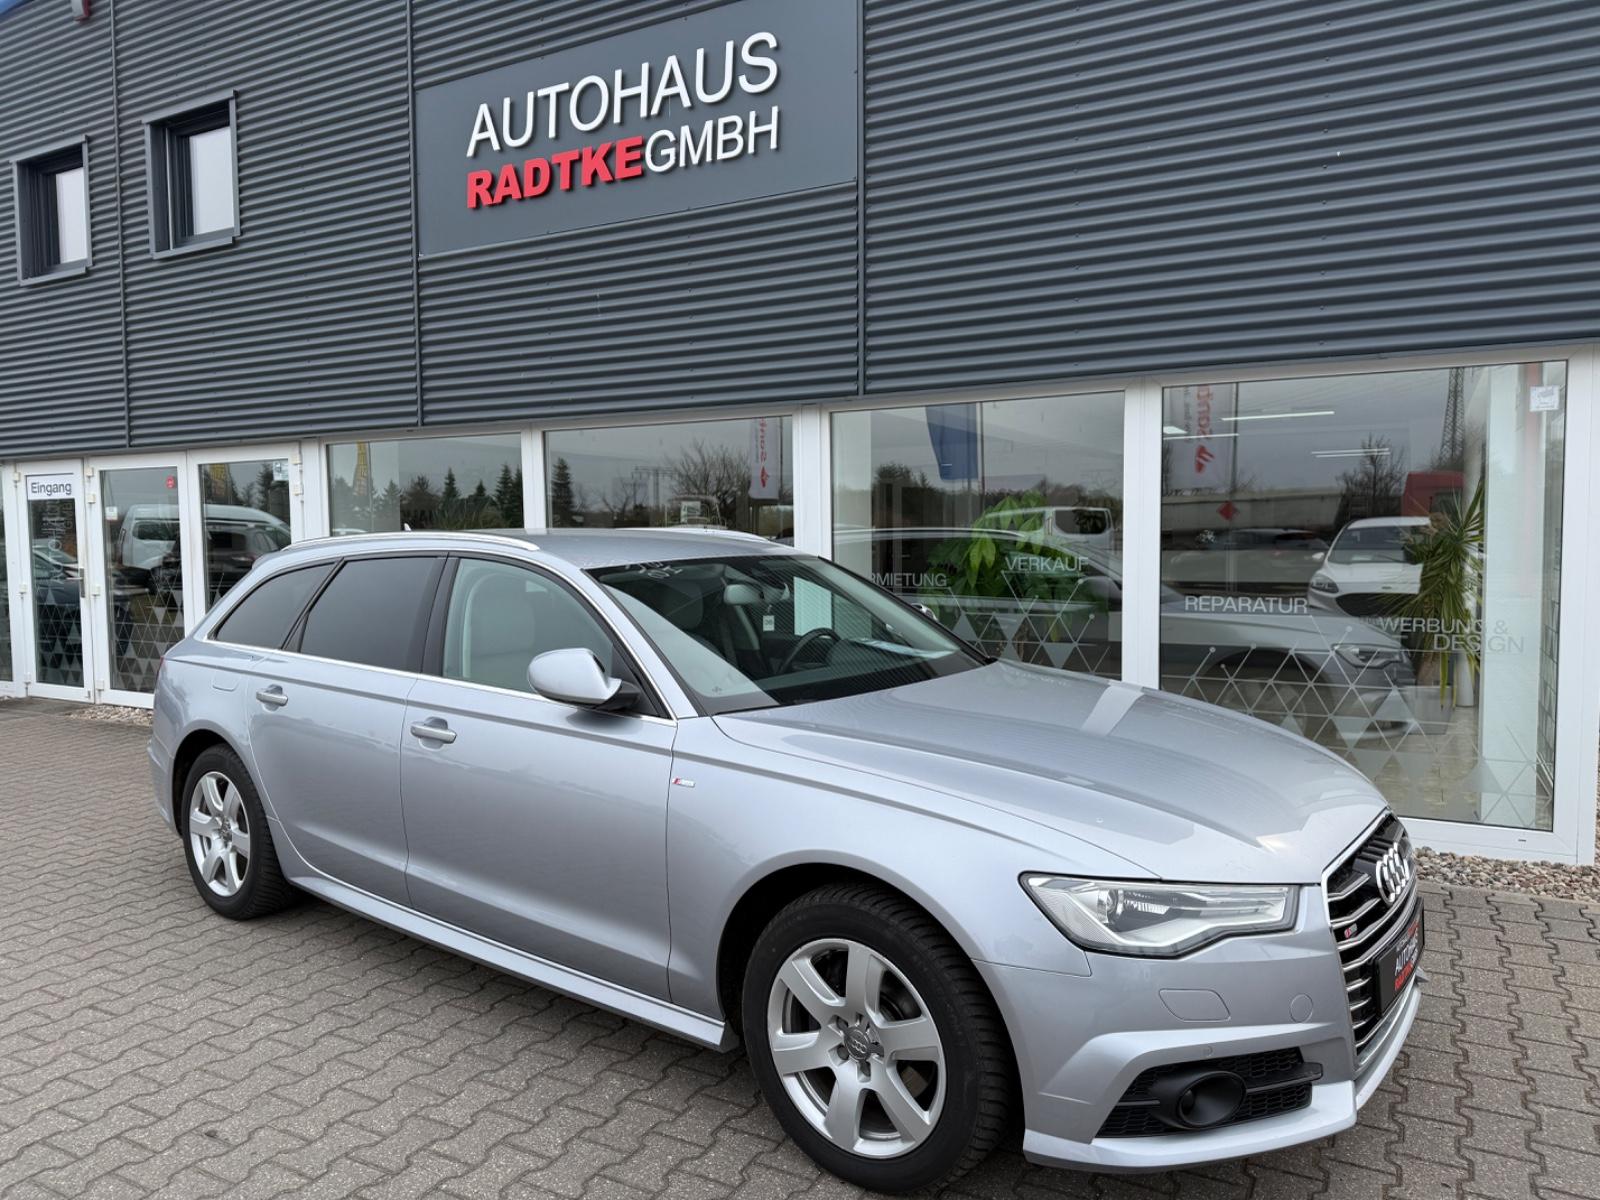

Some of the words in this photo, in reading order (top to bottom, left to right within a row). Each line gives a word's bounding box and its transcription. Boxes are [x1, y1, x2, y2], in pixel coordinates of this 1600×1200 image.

[467, 32, 778, 158] AUTOHAUS
[31, 482, 72, 496] Eingang
[1005, 557, 1088, 571] VERKAUF
[1184, 595, 1308, 614] REPARATUR
[1380, 617, 1486, 635] WERBUNG
[1493, 619, 1512, 635] &
[1433, 633, 1524, 653] DESIGN
